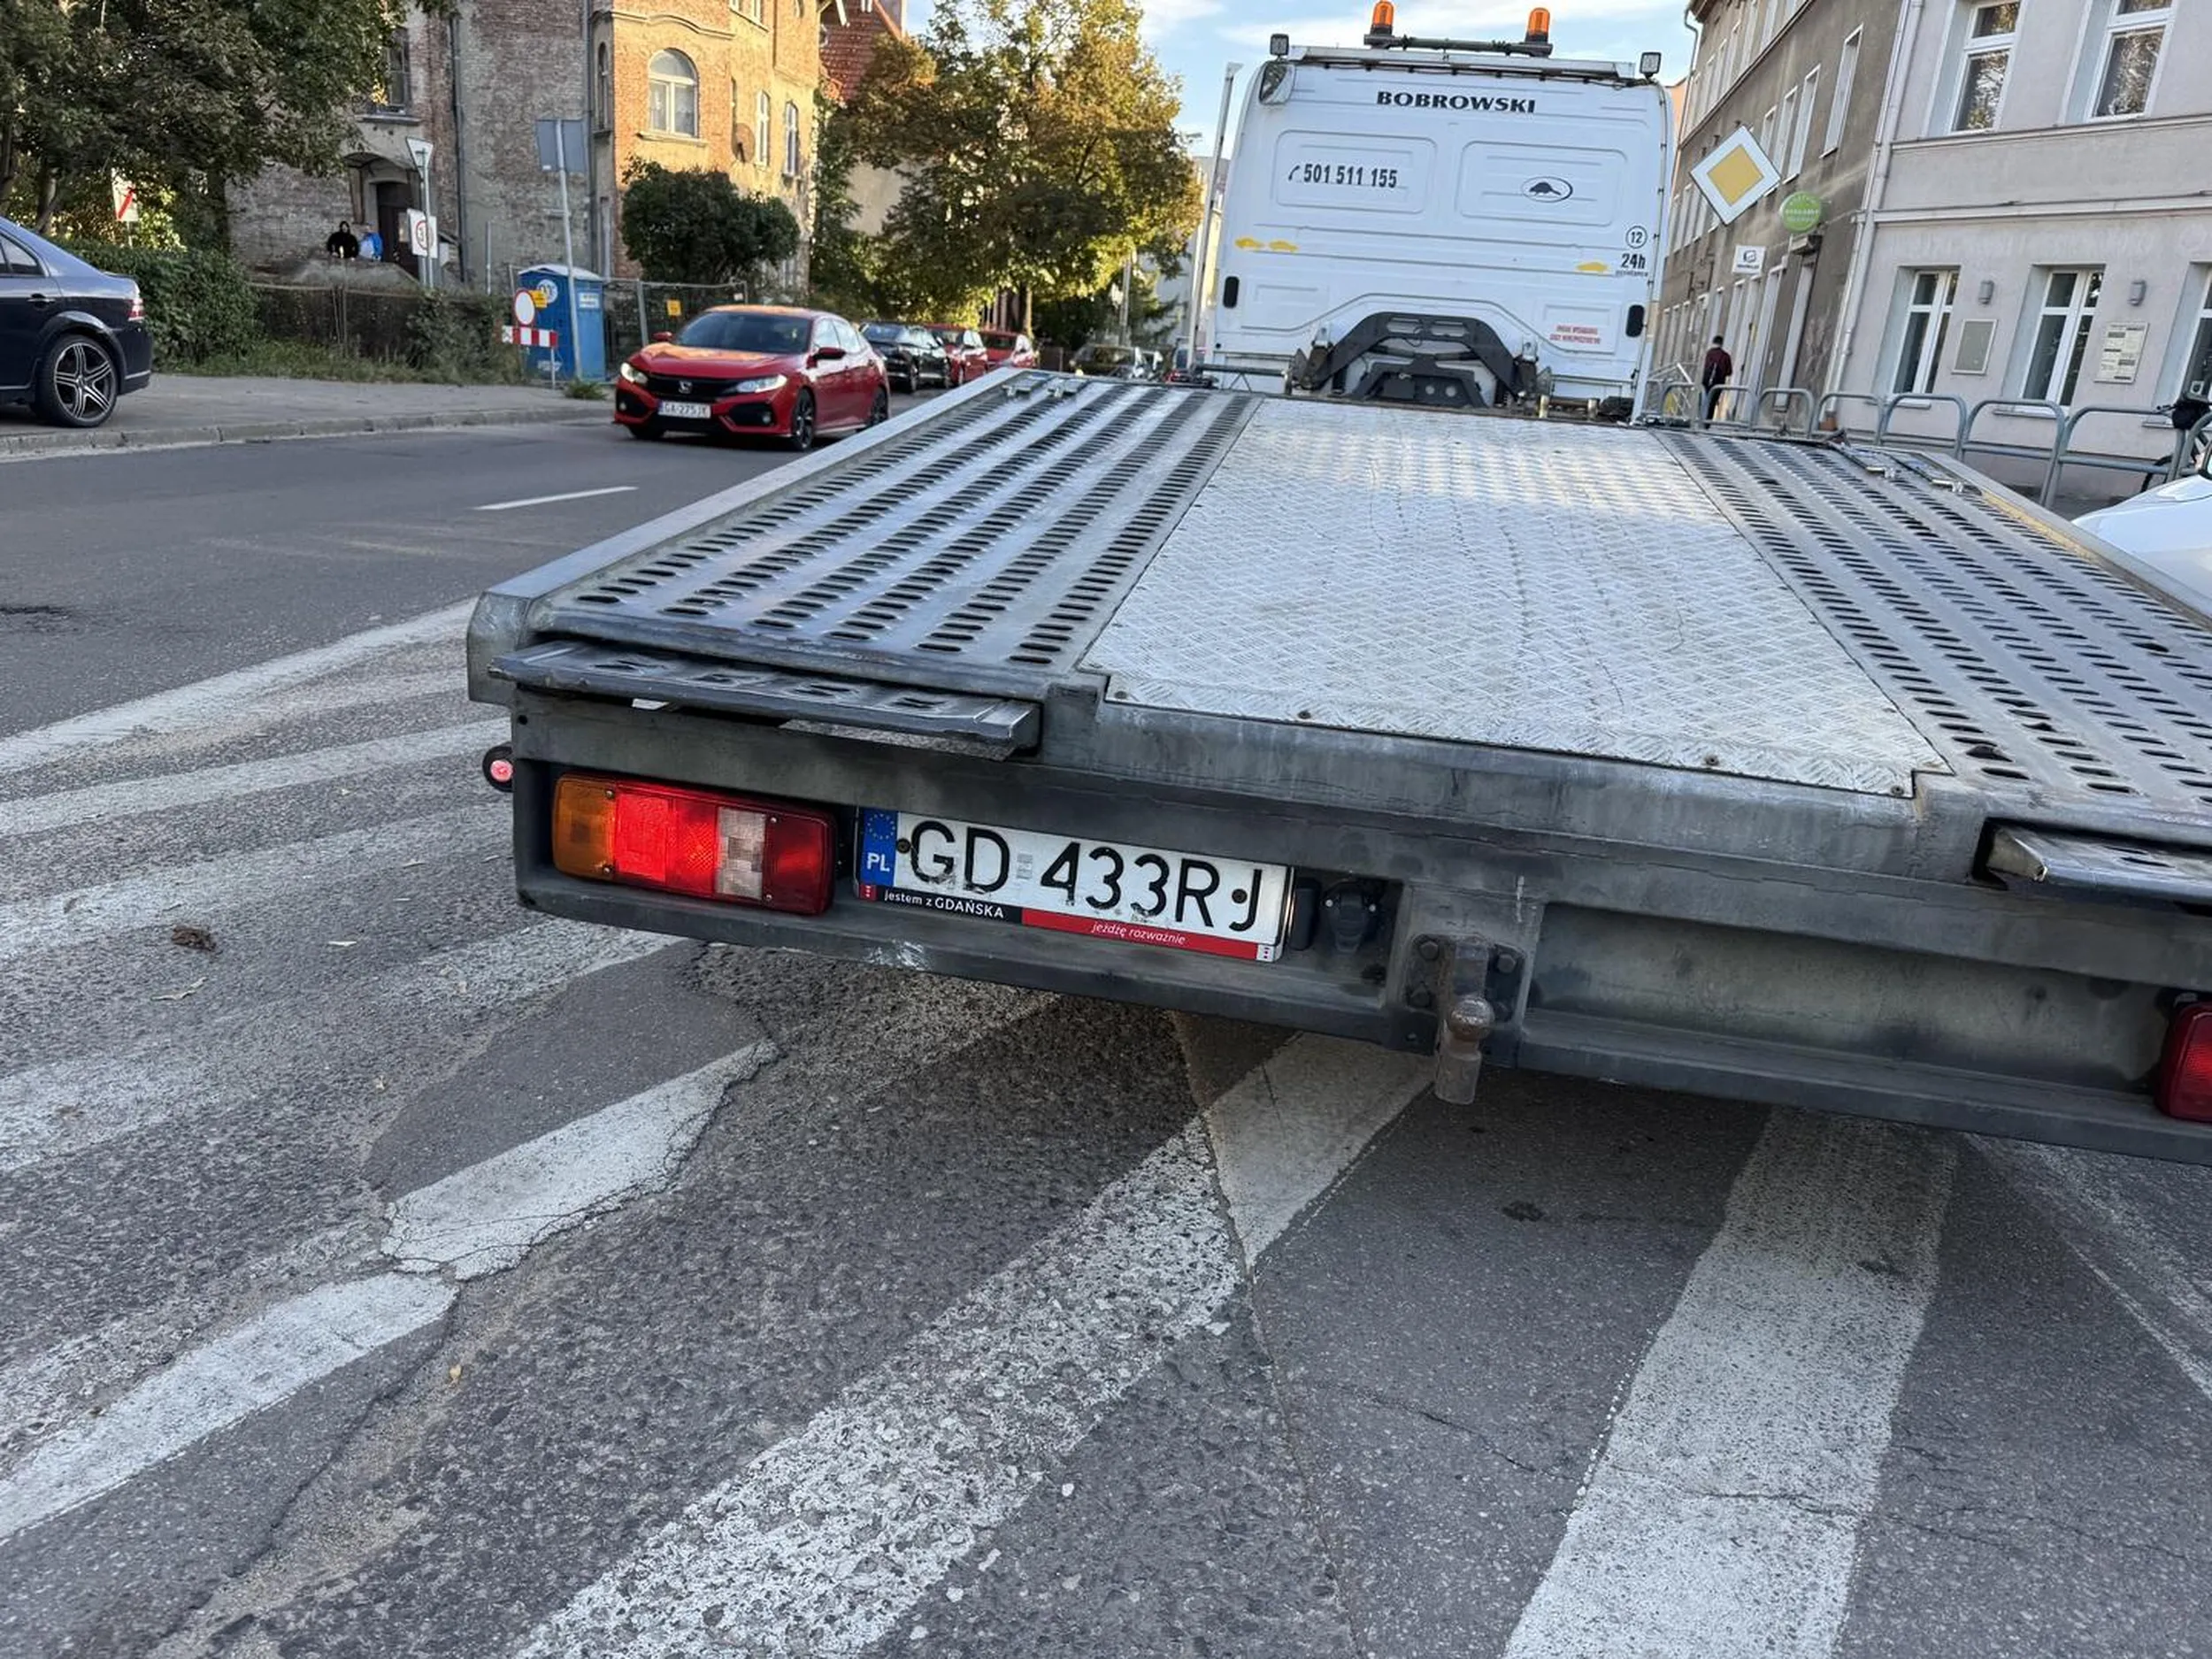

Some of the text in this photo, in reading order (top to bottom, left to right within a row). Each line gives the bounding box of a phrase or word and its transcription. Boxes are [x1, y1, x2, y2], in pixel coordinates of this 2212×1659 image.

[1376, 91, 1536, 113] BOBROWSKI
[1303, 163, 1398, 188] 501 511 155
[1631, 231, 1643, 243] 12
[1621, 253, 1647, 269] 24h
[866, 852, 891, 872] PL
[910, 820, 1263, 933] GD 433RJ
[884, 890, 1004, 918] jestem z GDAŃSKA
[1091, 921, 1186, 945] jeżdżę rozważnie
